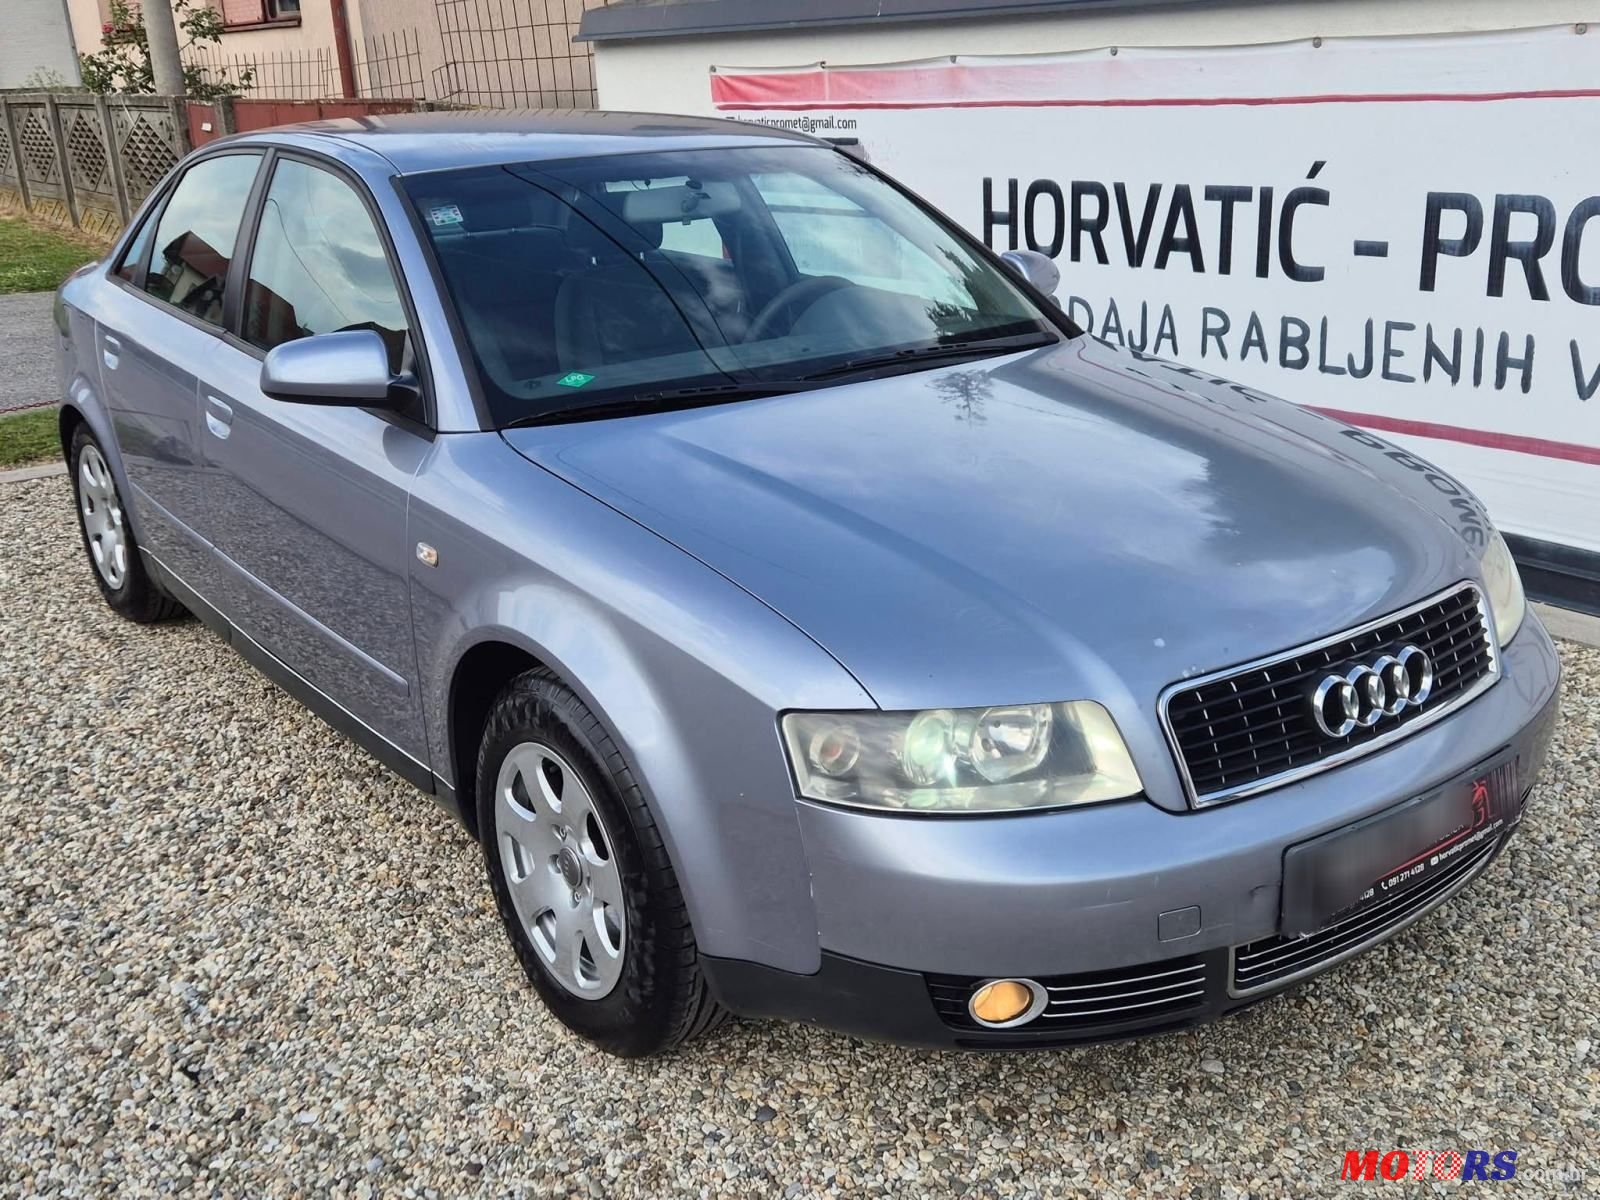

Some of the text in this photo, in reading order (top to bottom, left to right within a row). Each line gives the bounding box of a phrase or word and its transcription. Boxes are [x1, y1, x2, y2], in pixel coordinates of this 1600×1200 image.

[982, 160, 1331, 282] HORVATIĆ
[1068, 296, 1179, 357] DAJA
[1201, 307, 1535, 394] RABLJENIH
[1569, 338, 1600, 401] V
